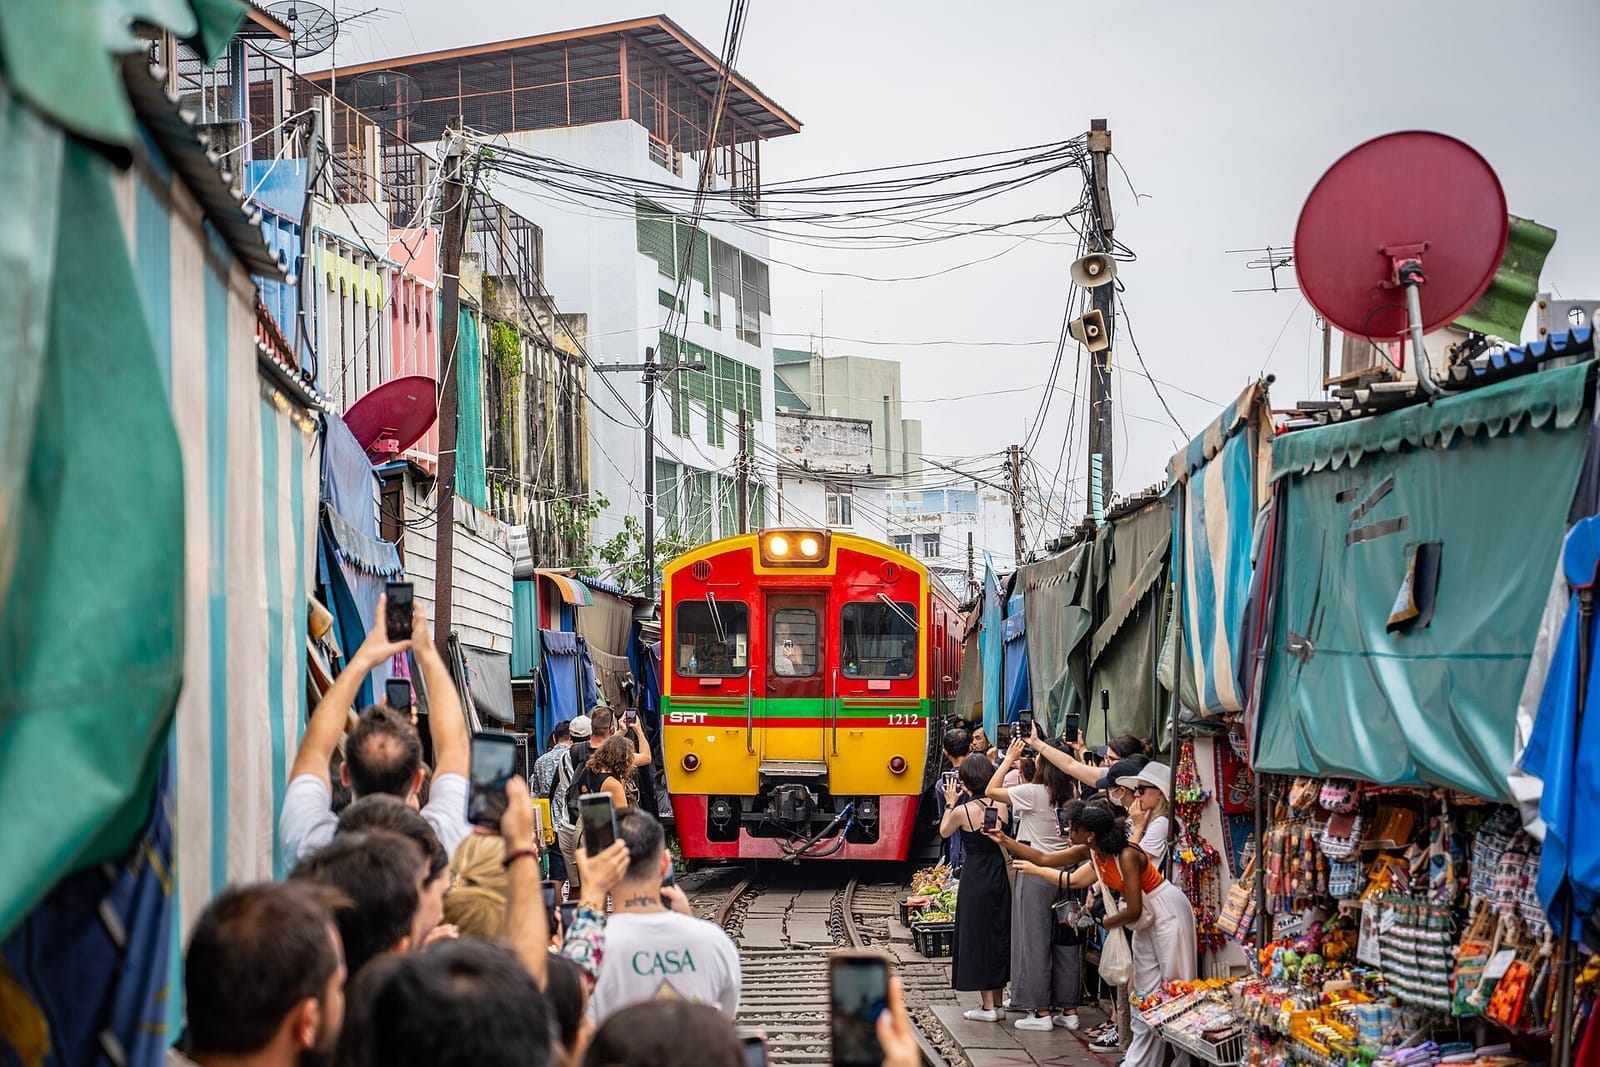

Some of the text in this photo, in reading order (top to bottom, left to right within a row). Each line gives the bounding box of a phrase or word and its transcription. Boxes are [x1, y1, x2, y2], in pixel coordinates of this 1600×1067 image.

[669, 711, 708, 724] SRT
[887, 713, 919, 726] 1212
[632, 949, 697, 976] CASA
